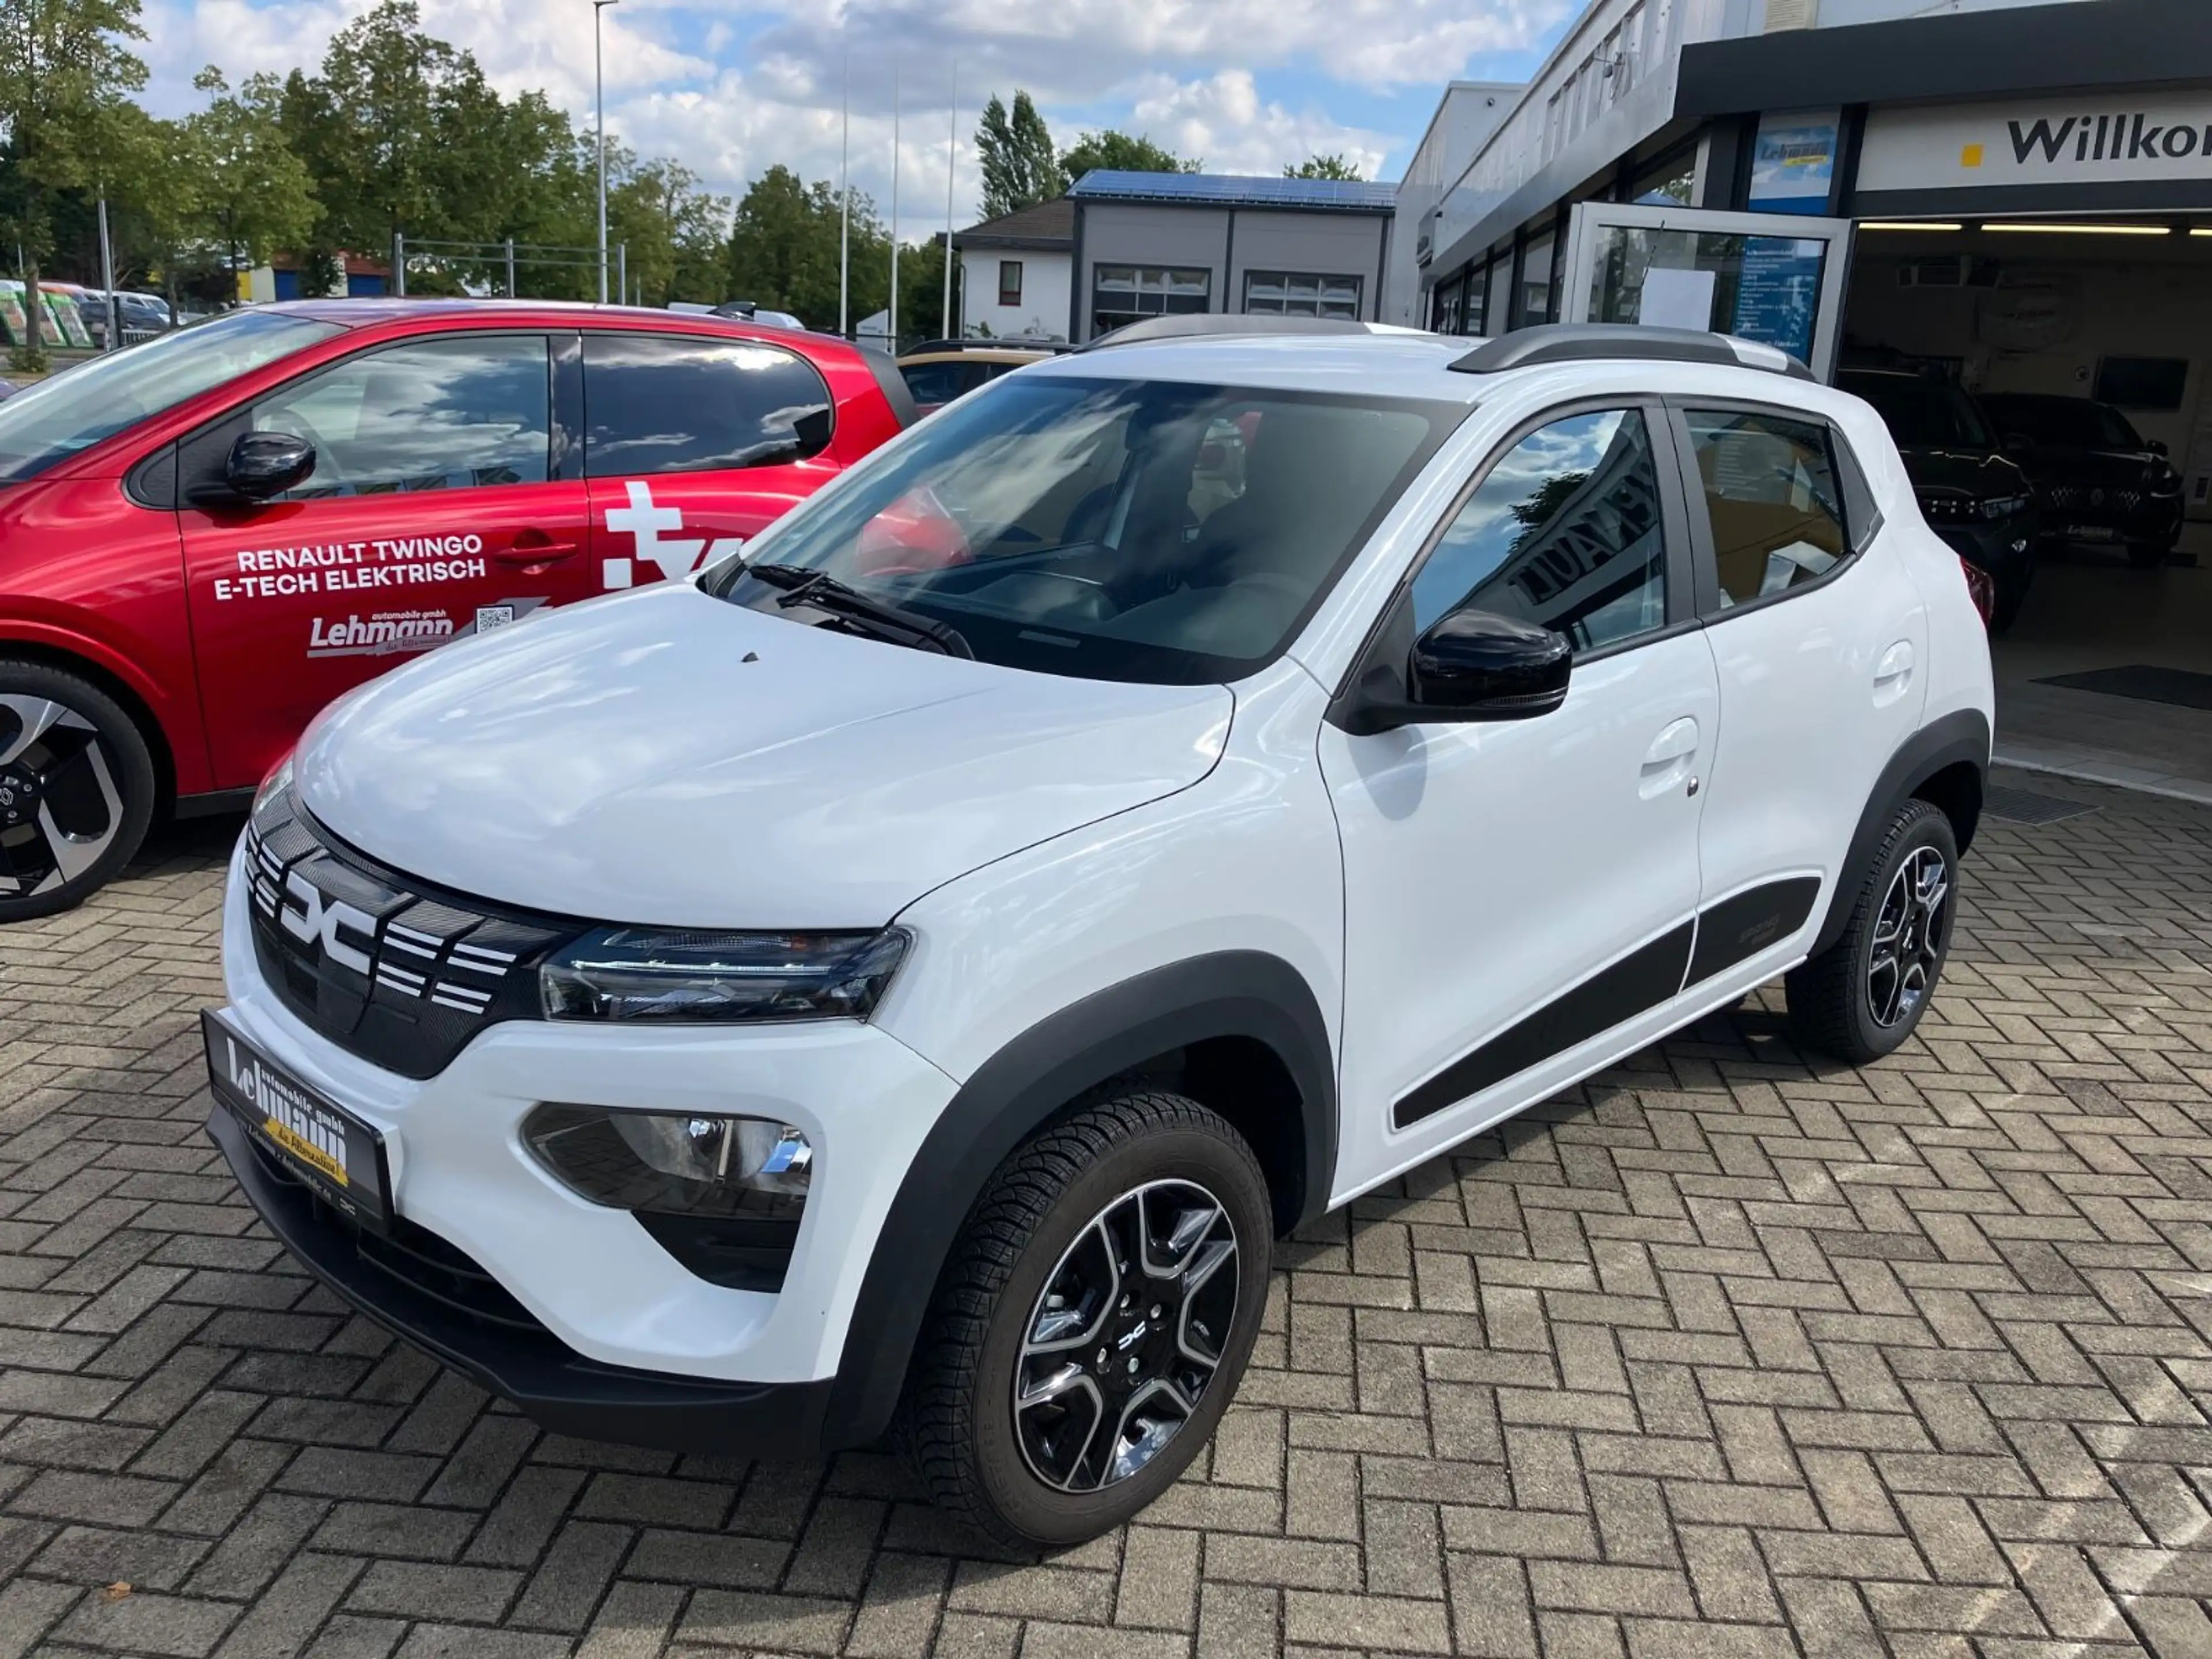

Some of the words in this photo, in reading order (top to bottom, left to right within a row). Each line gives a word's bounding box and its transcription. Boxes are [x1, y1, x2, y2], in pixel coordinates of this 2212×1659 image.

[237, 542, 366, 572] RENAULT
[372, 534, 483, 561] TWINGO
[214, 574, 319, 601] E-TECH
[325, 558, 486, 591] ELEKTRISCH
[310, 615, 454, 646] Lehmann
[372, 611, 421, 620] automobile
[422, 609, 446, 620] gmbh
[226, 1037, 346, 1171] Lehmann
